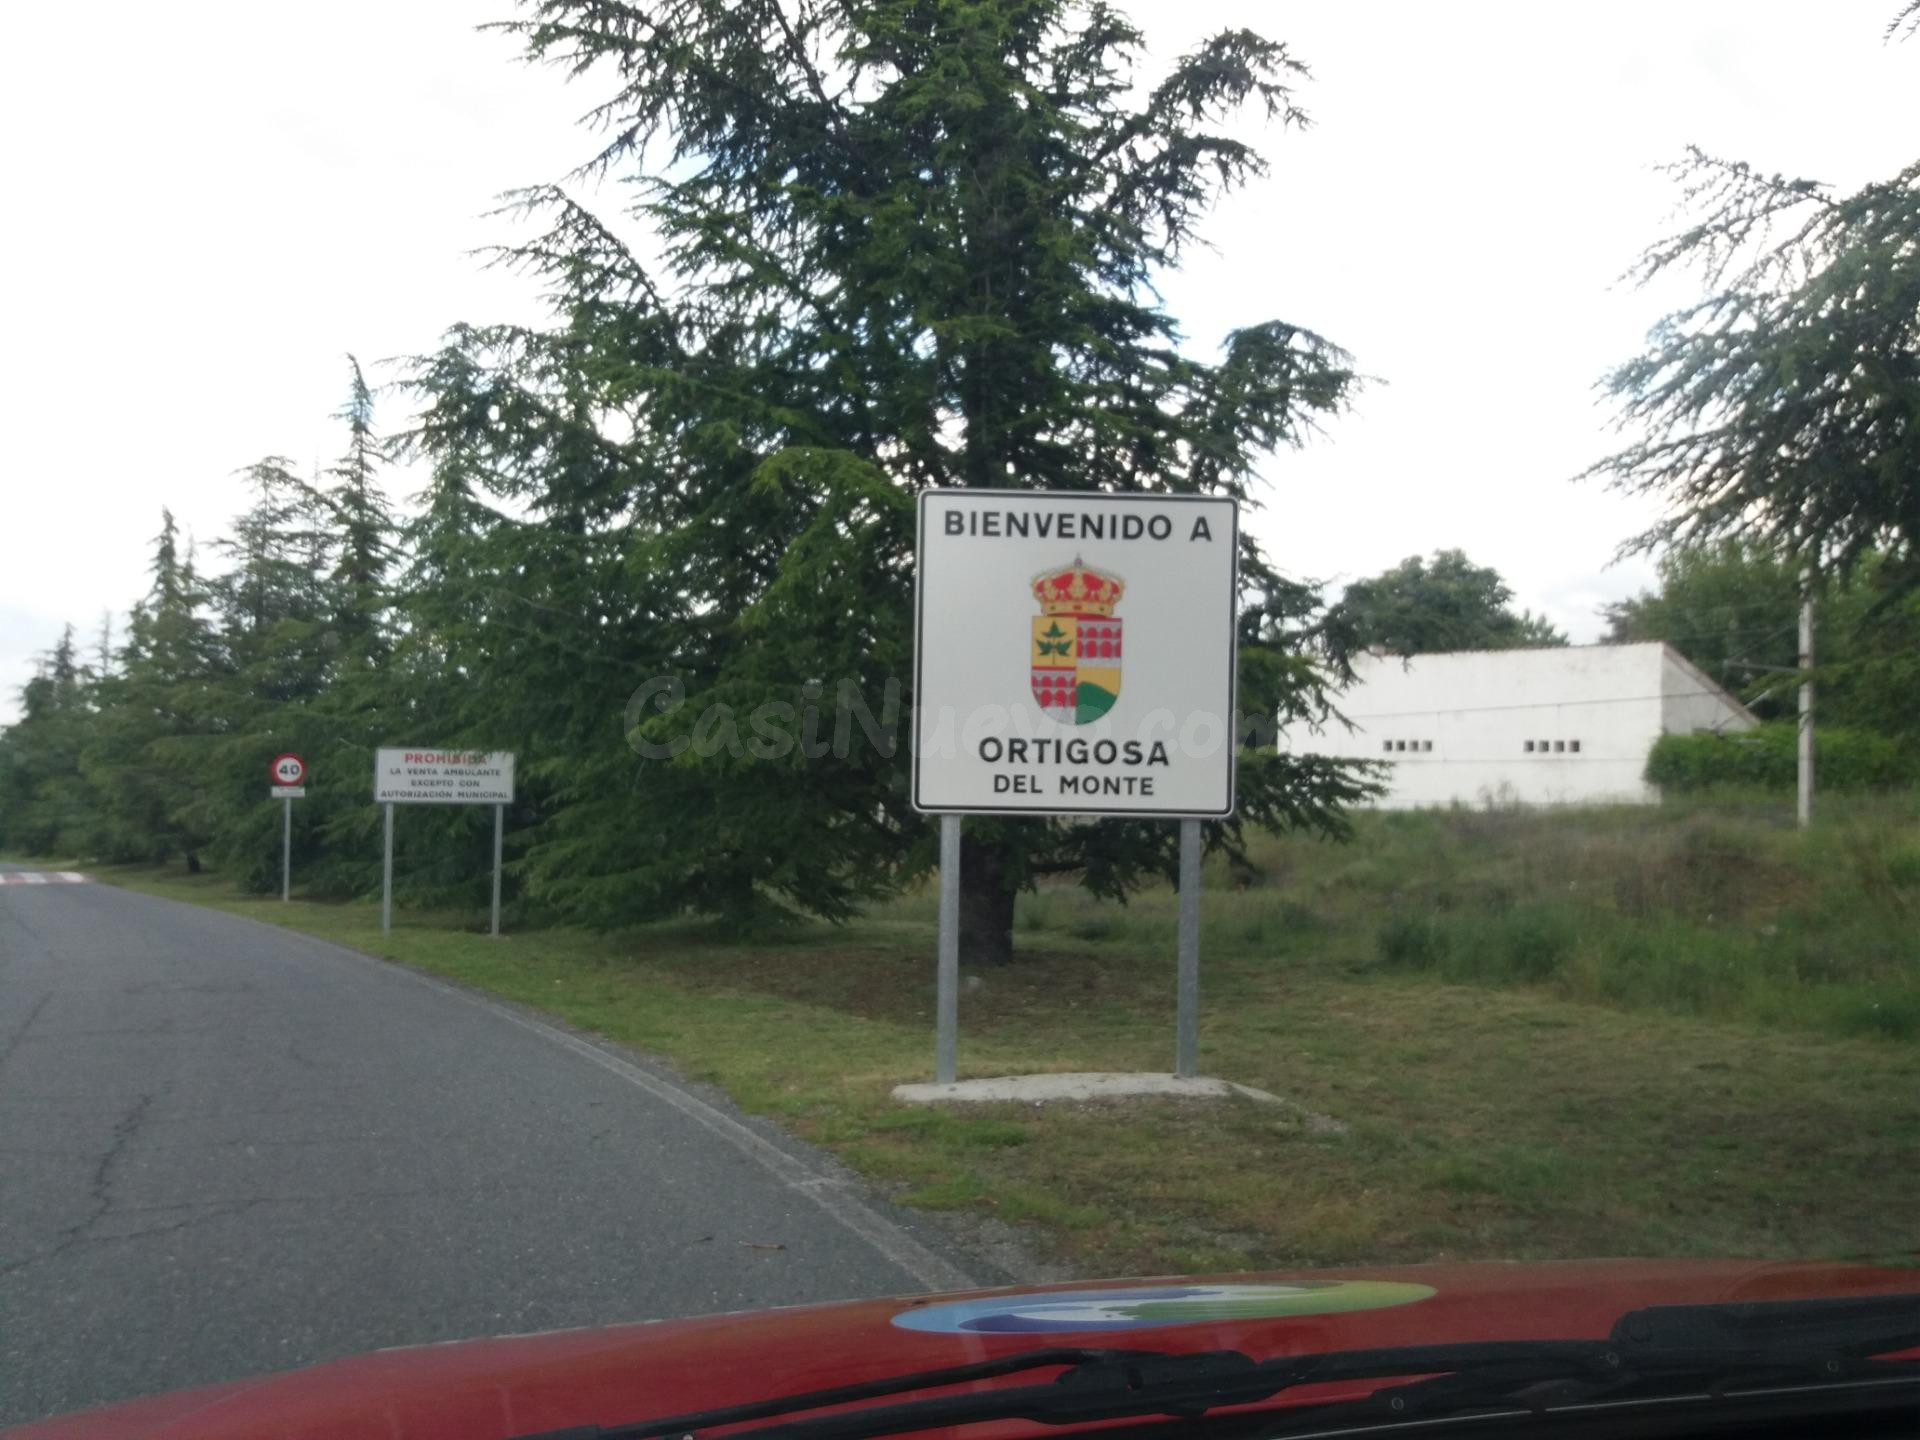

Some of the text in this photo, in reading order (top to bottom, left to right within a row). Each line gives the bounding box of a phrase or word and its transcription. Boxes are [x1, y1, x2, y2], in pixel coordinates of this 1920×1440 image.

[944, 510, 1213, 542] BIENVENIDO A
[978, 736, 1169, 766] ORTIGOSA
[279, 764, 300, 775] 40
[443, 768, 501, 776] AMBULANTE
[411, 779, 454, 787] EXCEPTO
[993, 774, 1155, 796] DEL MONTE
[458, 790, 508, 798] MUNICIPAL
